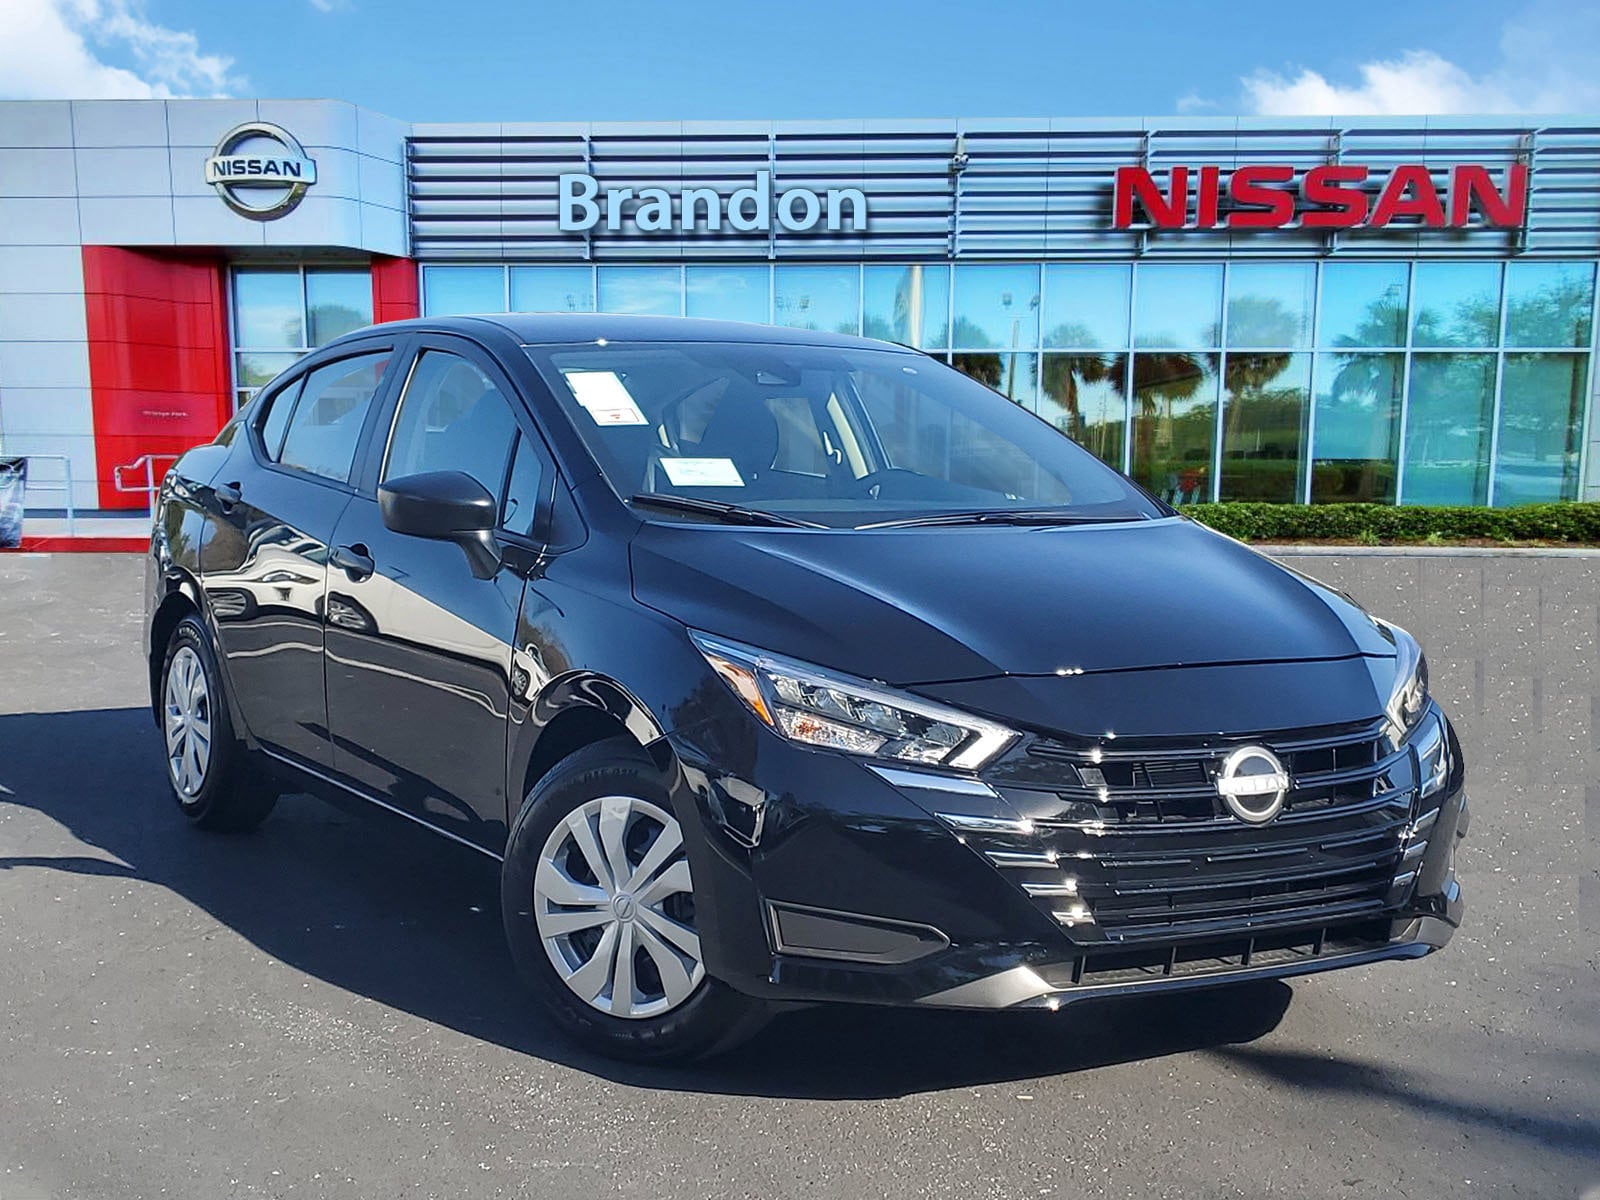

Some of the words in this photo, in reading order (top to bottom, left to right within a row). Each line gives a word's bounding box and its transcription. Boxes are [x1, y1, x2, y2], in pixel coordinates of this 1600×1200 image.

[213, 160, 301, 177] NISSAN
[559, 170, 867, 231] Brandon
[1113, 165, 1528, 229] NISSAN
[1223, 774, 1288, 793] ISSAN
